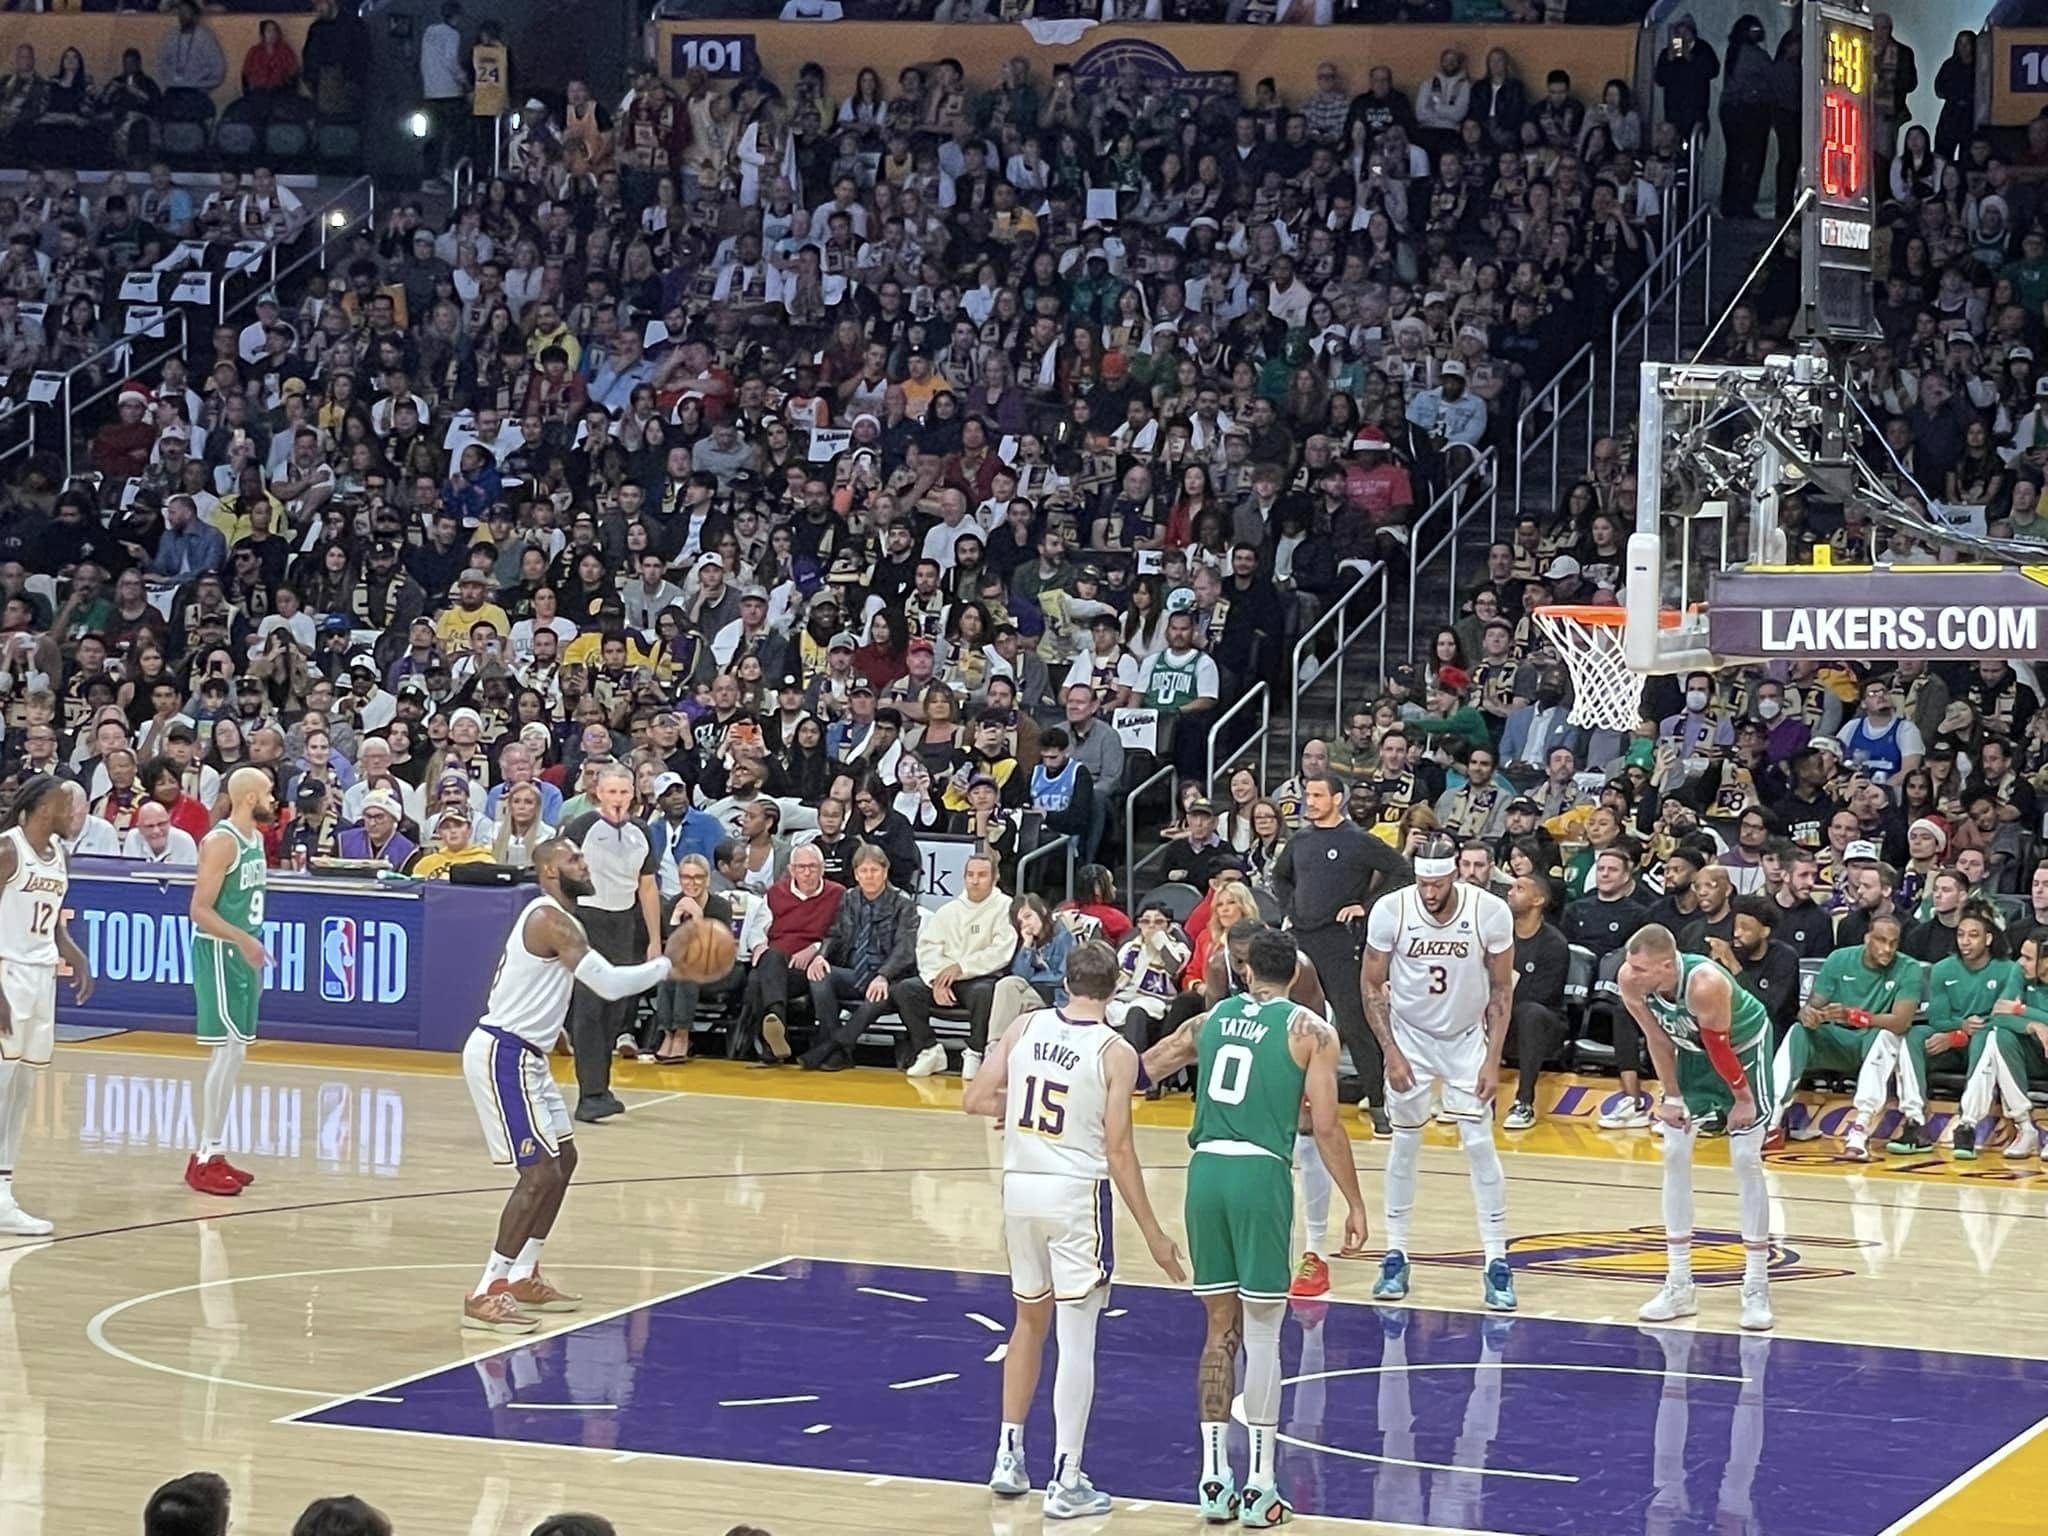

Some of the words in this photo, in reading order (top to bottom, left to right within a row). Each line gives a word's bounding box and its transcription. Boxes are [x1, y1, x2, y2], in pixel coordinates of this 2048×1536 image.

[682, 40, 741, 72] 101
[478, 66, 499, 82] 24
[1822, 95, 1861, 195] 24
[1761, 606, 2037, 650] LAKERS.COM
[31, 901, 53, 935] 12
[248, 890, 264, 925] 9
[84, 910, 194, 985] TODAY
[362, 920, 408, 1004] iD
[1407, 937, 1469, 959] LAKERS
[1429, 966, 1447, 994] 3
[1219, 1017, 1269, 1044] TATUM
[1034, 1042, 1080, 1071] REAVES
[1207, 1043, 1253, 1105] 0
[1017, 1074, 1069, 1139] 15
